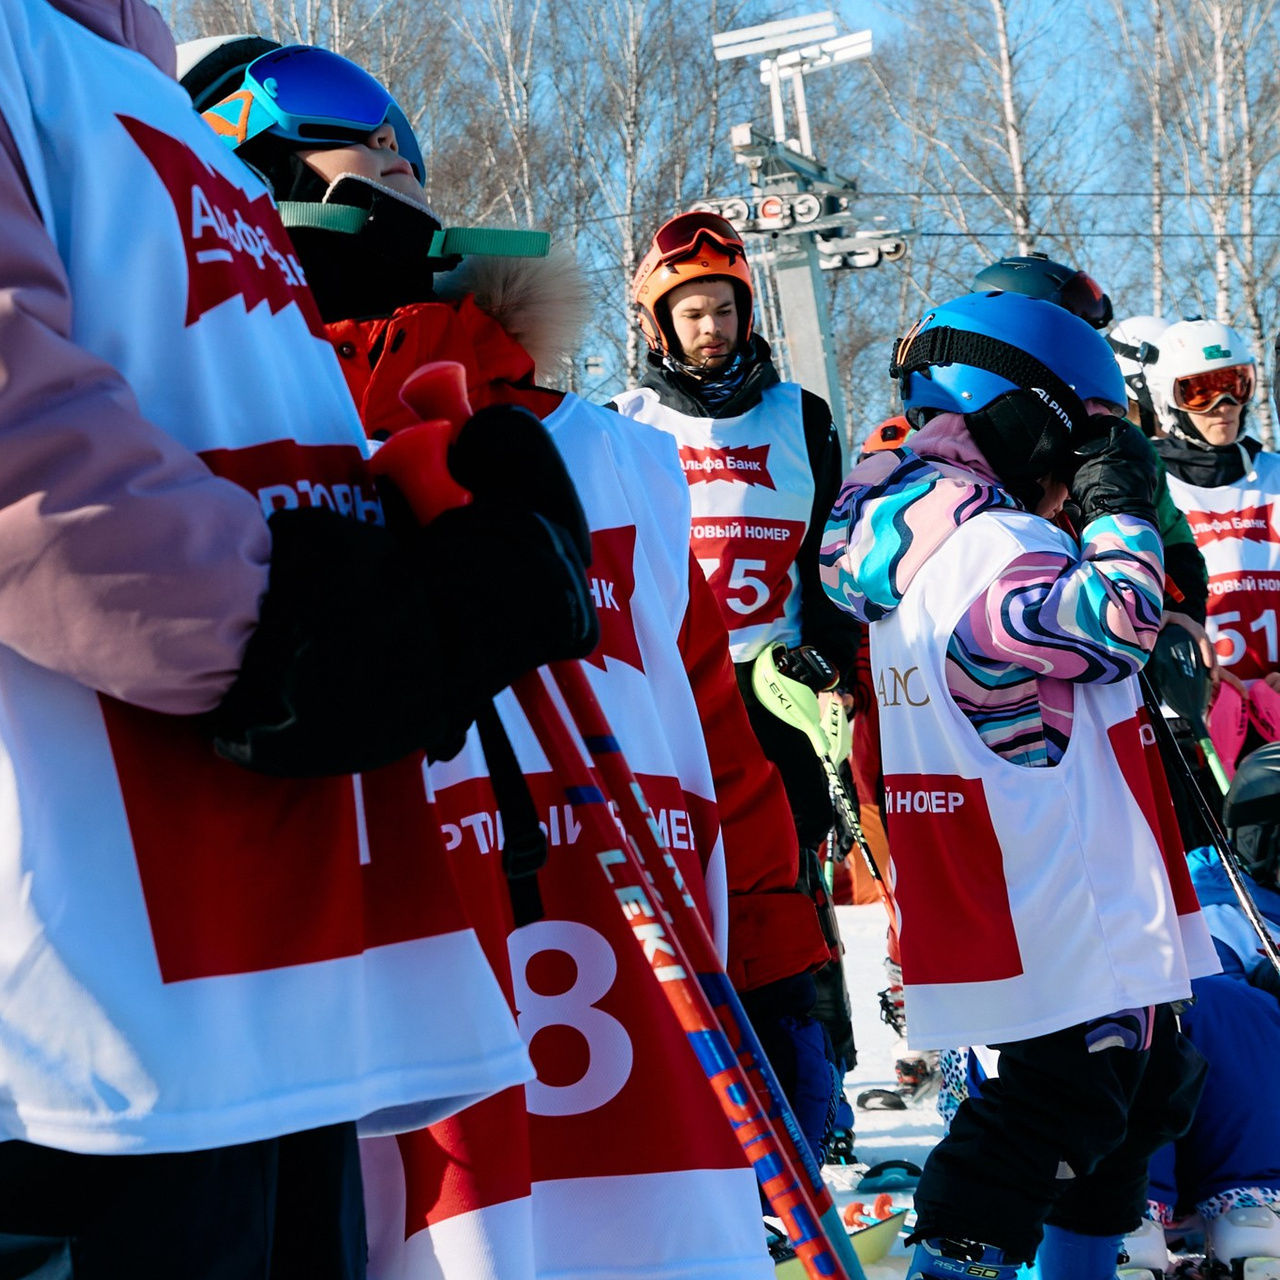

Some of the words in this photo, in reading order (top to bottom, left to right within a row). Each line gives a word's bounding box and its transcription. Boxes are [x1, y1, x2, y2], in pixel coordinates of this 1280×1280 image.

[1031, 387, 1073, 433] ALPINA
[726, 456, 761, 471] Банк
[745, 526, 790, 541] НОМЕР
[1231, 517, 1267, 530] Банк
[1206, 609, 1279, 667] 51
[831, 702, 840, 737] LEKI
[895, 791, 964, 814] НОЕР
[597, 849, 687, 983] LEKI
[507, 920, 633, 1116] 8
[933, 1260, 965, 1273] RSJ
[966, 1265, 1000, 1280] 60
